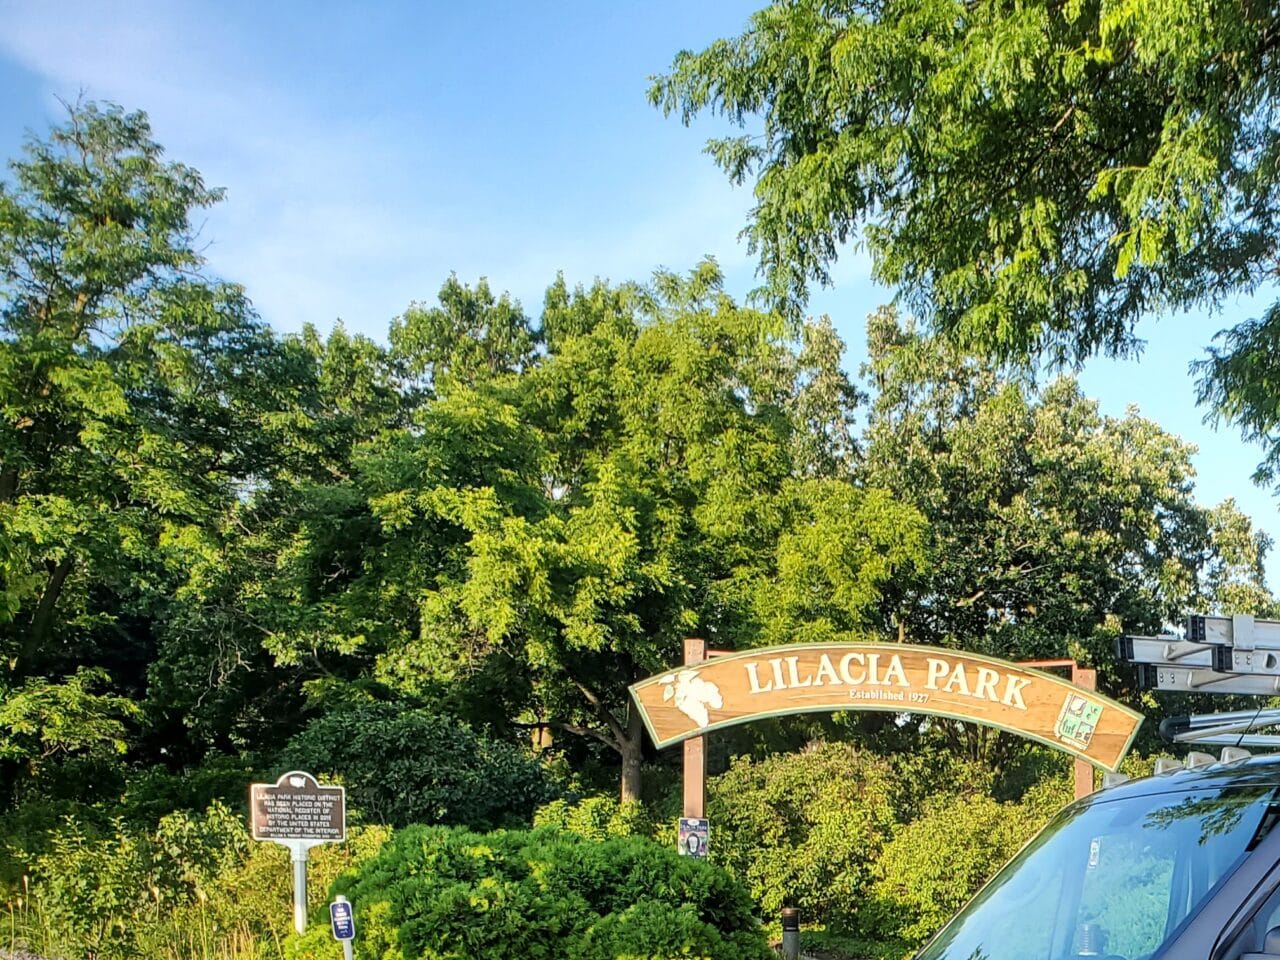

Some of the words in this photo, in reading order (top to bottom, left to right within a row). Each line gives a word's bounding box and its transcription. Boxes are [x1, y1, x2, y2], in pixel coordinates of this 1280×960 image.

[744, 652, 911, 694] LILACIA
[924, 657, 1032, 711] PARK
[849, 688, 904, 701] Established
[908, 692, 929, 704] 1927
